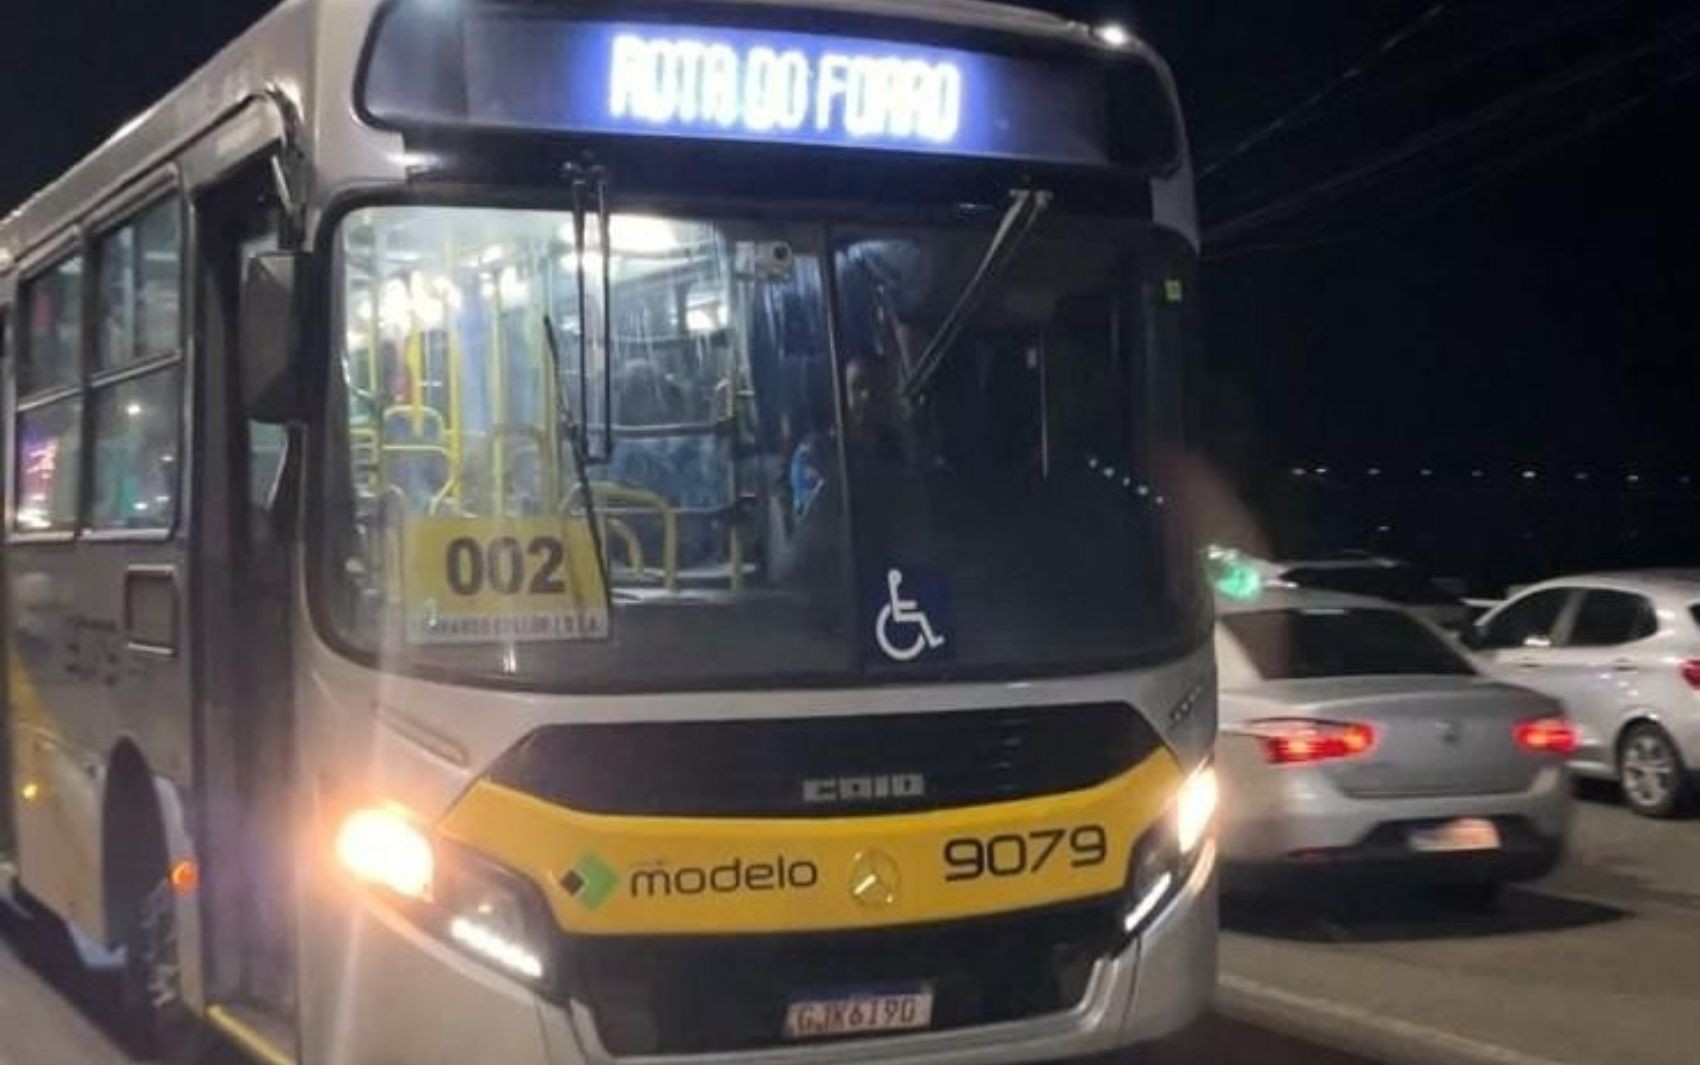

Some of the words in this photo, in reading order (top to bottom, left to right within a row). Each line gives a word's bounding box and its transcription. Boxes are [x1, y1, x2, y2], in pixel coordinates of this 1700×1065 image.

[611, 35, 739, 127] ROTA
[743, 46, 808, 130] DO
[446, 535, 566, 596] 002
[803, 773, 924, 801] CAIO
[630, 854, 818, 897] modelo
[943, 824, 1107, 882] 9079
